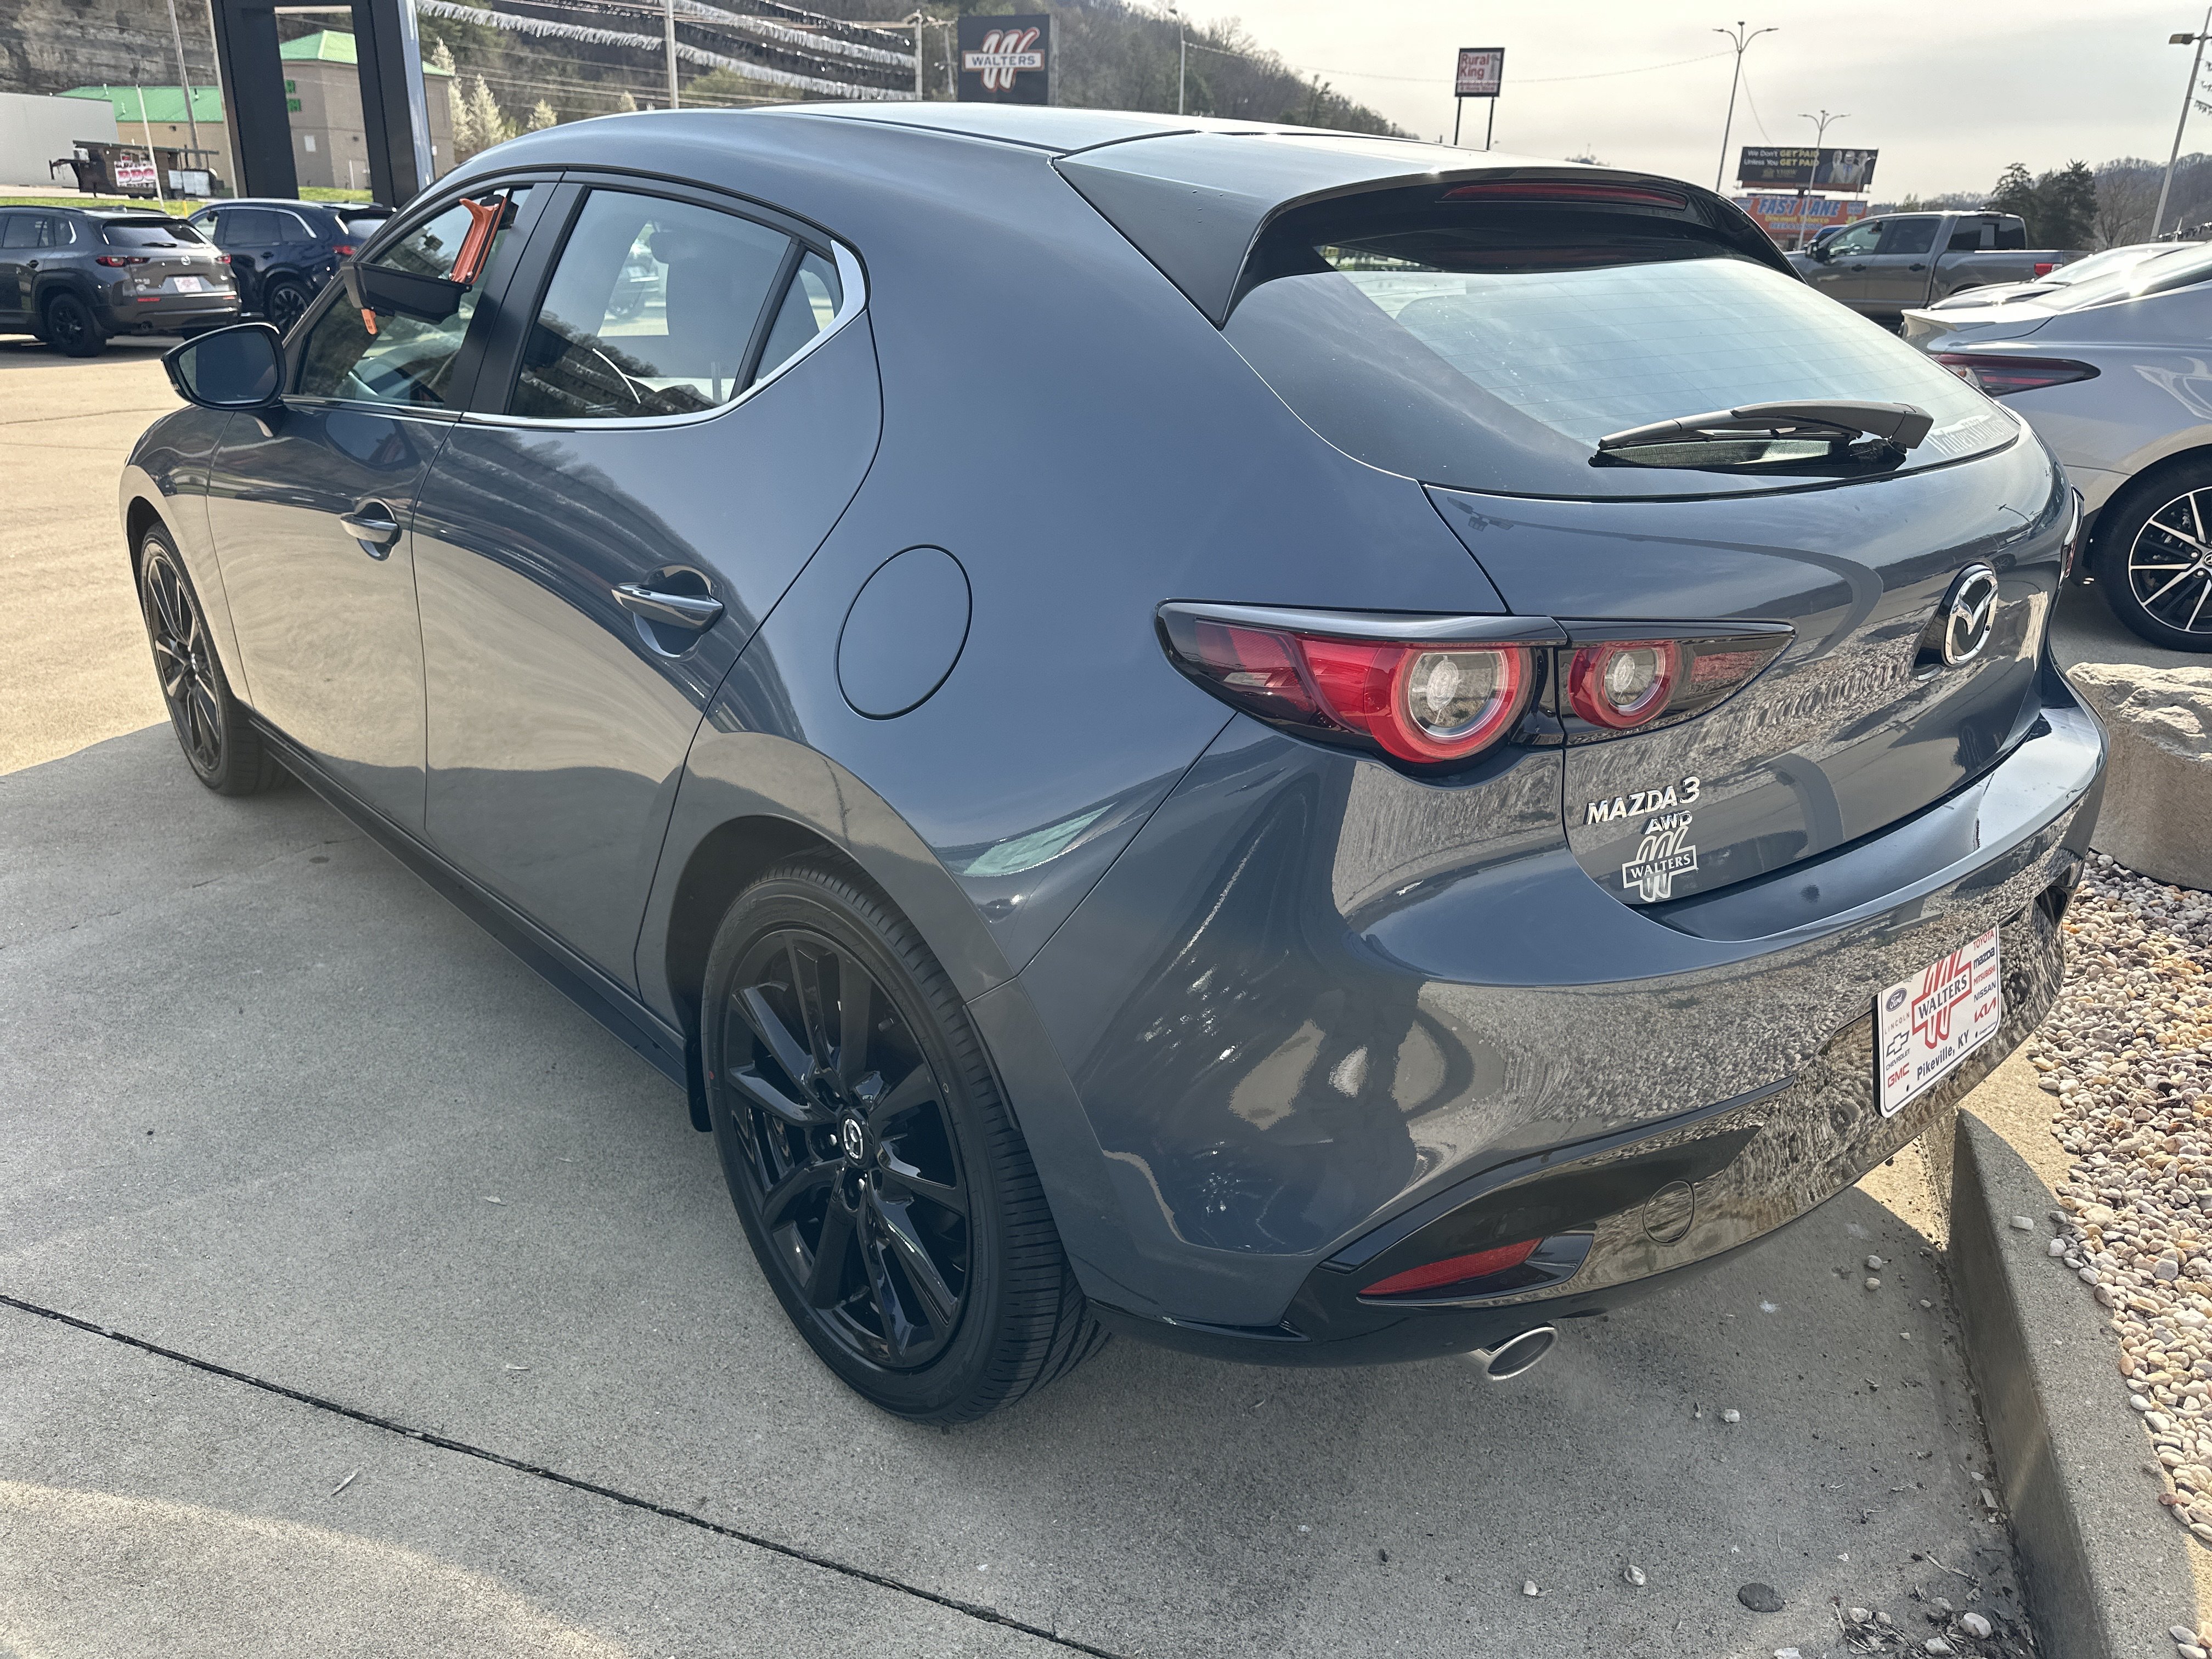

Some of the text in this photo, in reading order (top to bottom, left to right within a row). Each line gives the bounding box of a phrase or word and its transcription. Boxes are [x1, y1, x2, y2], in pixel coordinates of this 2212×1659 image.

[971, 55, 1036, 66] WALTERS
[1462, 53, 1489, 65] Rural
[1460, 66, 1485, 80] King
[1780, 149, 1797, 158] GET
[1799, 150, 1820, 158] PAID
[1780, 158, 1797, 166] GET
[1799, 159, 1820, 167] PAID
[1757, 199, 1798, 215] FAST
[1799, 215, 1830, 224] Tbacco
[1644, 810, 1692, 834] AWD
[1630, 853, 1691, 879] WALTERS
[1973, 929, 1995, 951] TOYOTA
[1973, 964, 1996, 986] MITSUBISHI
[1890, 992, 1904, 1009] Ford
[1918, 974, 1967, 1019] WALTERS
[1974, 980, 1996, 1003] NISSAN
[1884, 1011, 1910, 1035] LINCOLN
[1886, 1048, 1910, 1071] CHEVROLET
[1917, 1029, 1970, 1081] Pikeville, KY
[1887, 1062, 1910, 1088] GMC
